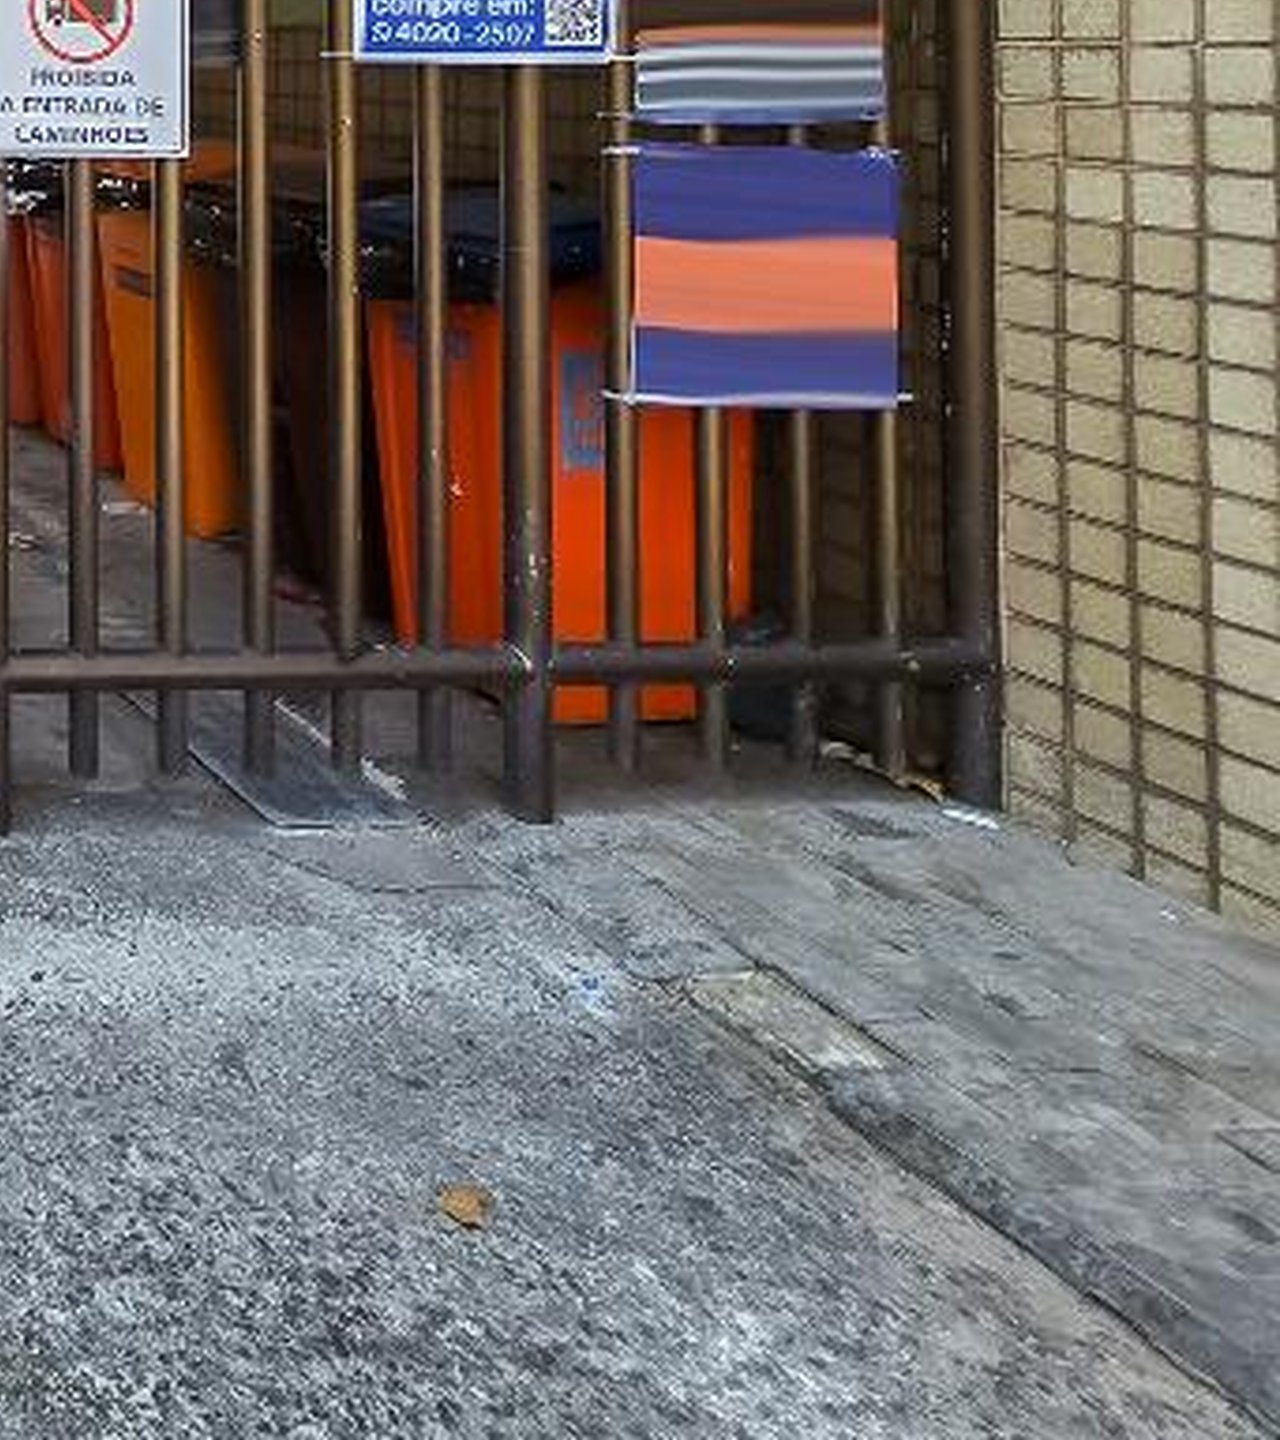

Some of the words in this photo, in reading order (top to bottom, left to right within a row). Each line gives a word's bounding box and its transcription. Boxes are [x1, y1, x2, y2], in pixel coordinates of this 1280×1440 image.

[0, 96, 14, 113] A
[23, 96, 126, 114] ENTRADA
[136, 97, 164, 117] DE
